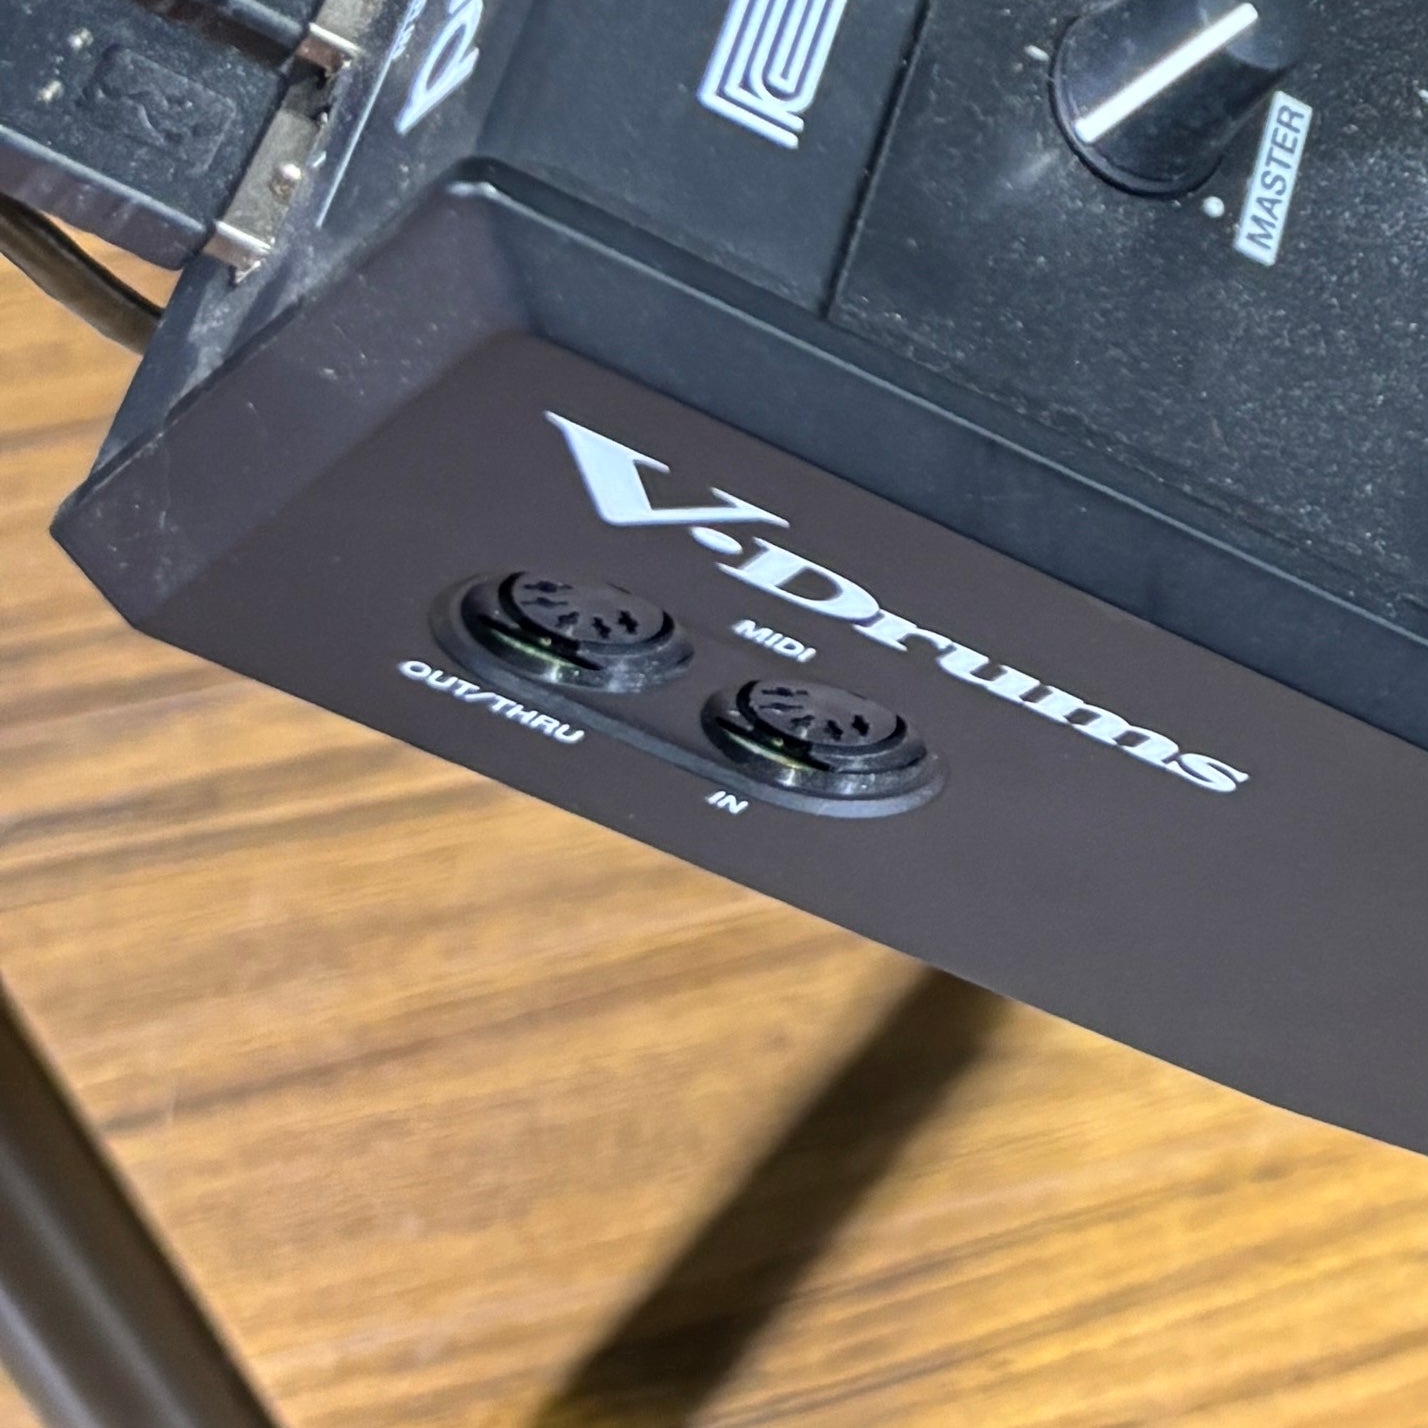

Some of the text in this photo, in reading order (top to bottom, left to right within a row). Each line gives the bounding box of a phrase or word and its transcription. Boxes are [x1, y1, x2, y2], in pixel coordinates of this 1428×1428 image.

[1244, 102, 1306, 252] MASTER
[732, 618, 818, 663] MIDI
[397, 659, 586, 746] OUT/THRU
[705, 790, 750, 817] IN
